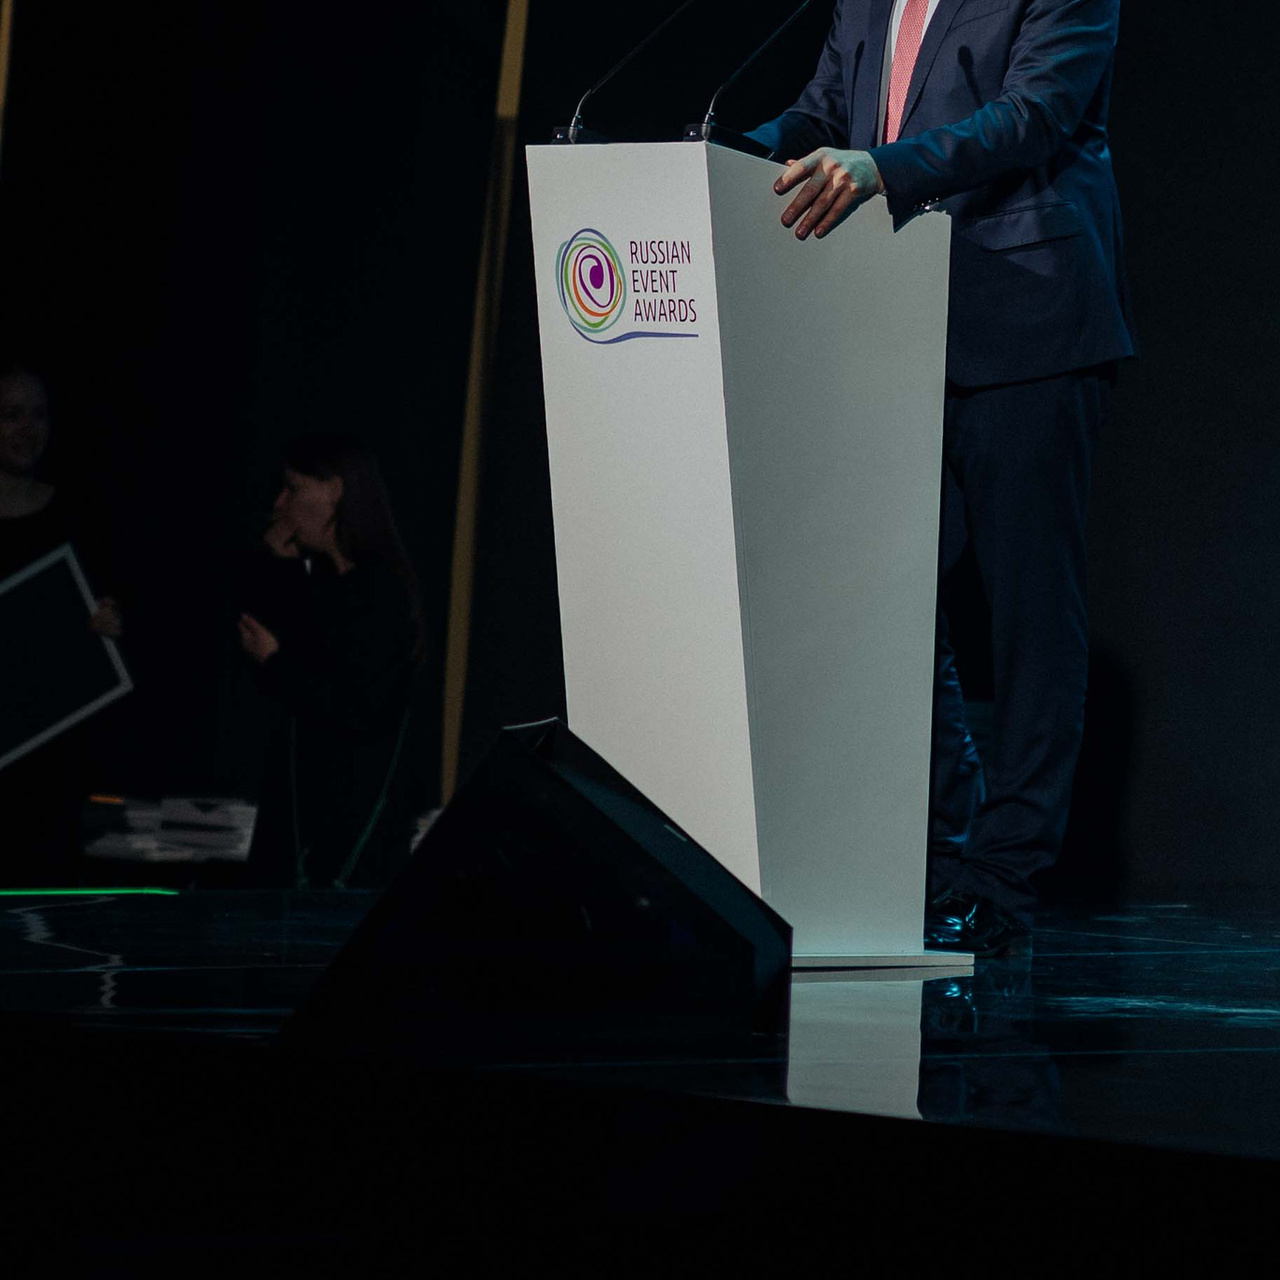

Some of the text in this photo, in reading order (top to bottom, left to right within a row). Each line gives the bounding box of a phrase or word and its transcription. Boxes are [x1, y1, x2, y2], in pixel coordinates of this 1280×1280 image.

[629, 240, 691, 265] RUSSIAN
[631, 269, 678, 293] EVENT
[634, 298, 697, 323] AWARDS
